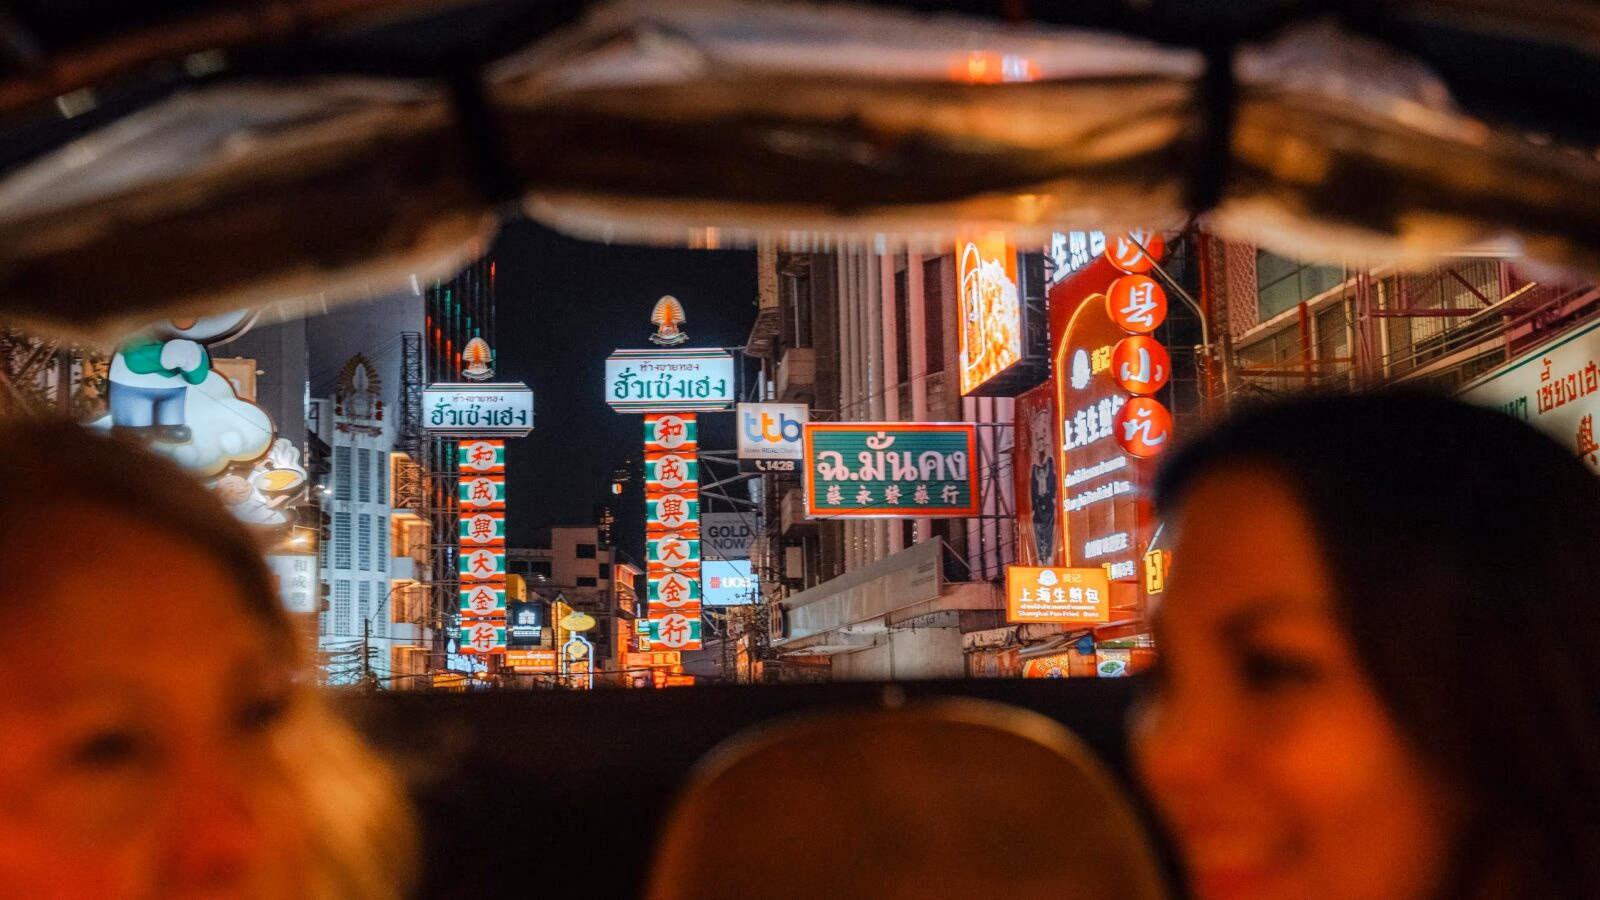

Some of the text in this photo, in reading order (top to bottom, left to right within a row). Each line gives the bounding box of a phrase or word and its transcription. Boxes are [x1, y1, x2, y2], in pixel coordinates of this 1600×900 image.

[614, 367, 726, 400] ฮั่วเซ่งเฮง
[431, 397, 527, 426] ฮั่วเซ่งเฮง
[744, 412, 803, 443] ttb
[765, 460, 795, 471] 1428
[817, 431, 967, 481] ฉ.มั่นคง
[708, 526, 750, 538] GOLD
[713, 538, 746, 549] NOW
[1019, 586, 1100, 604] 上海生煎包
